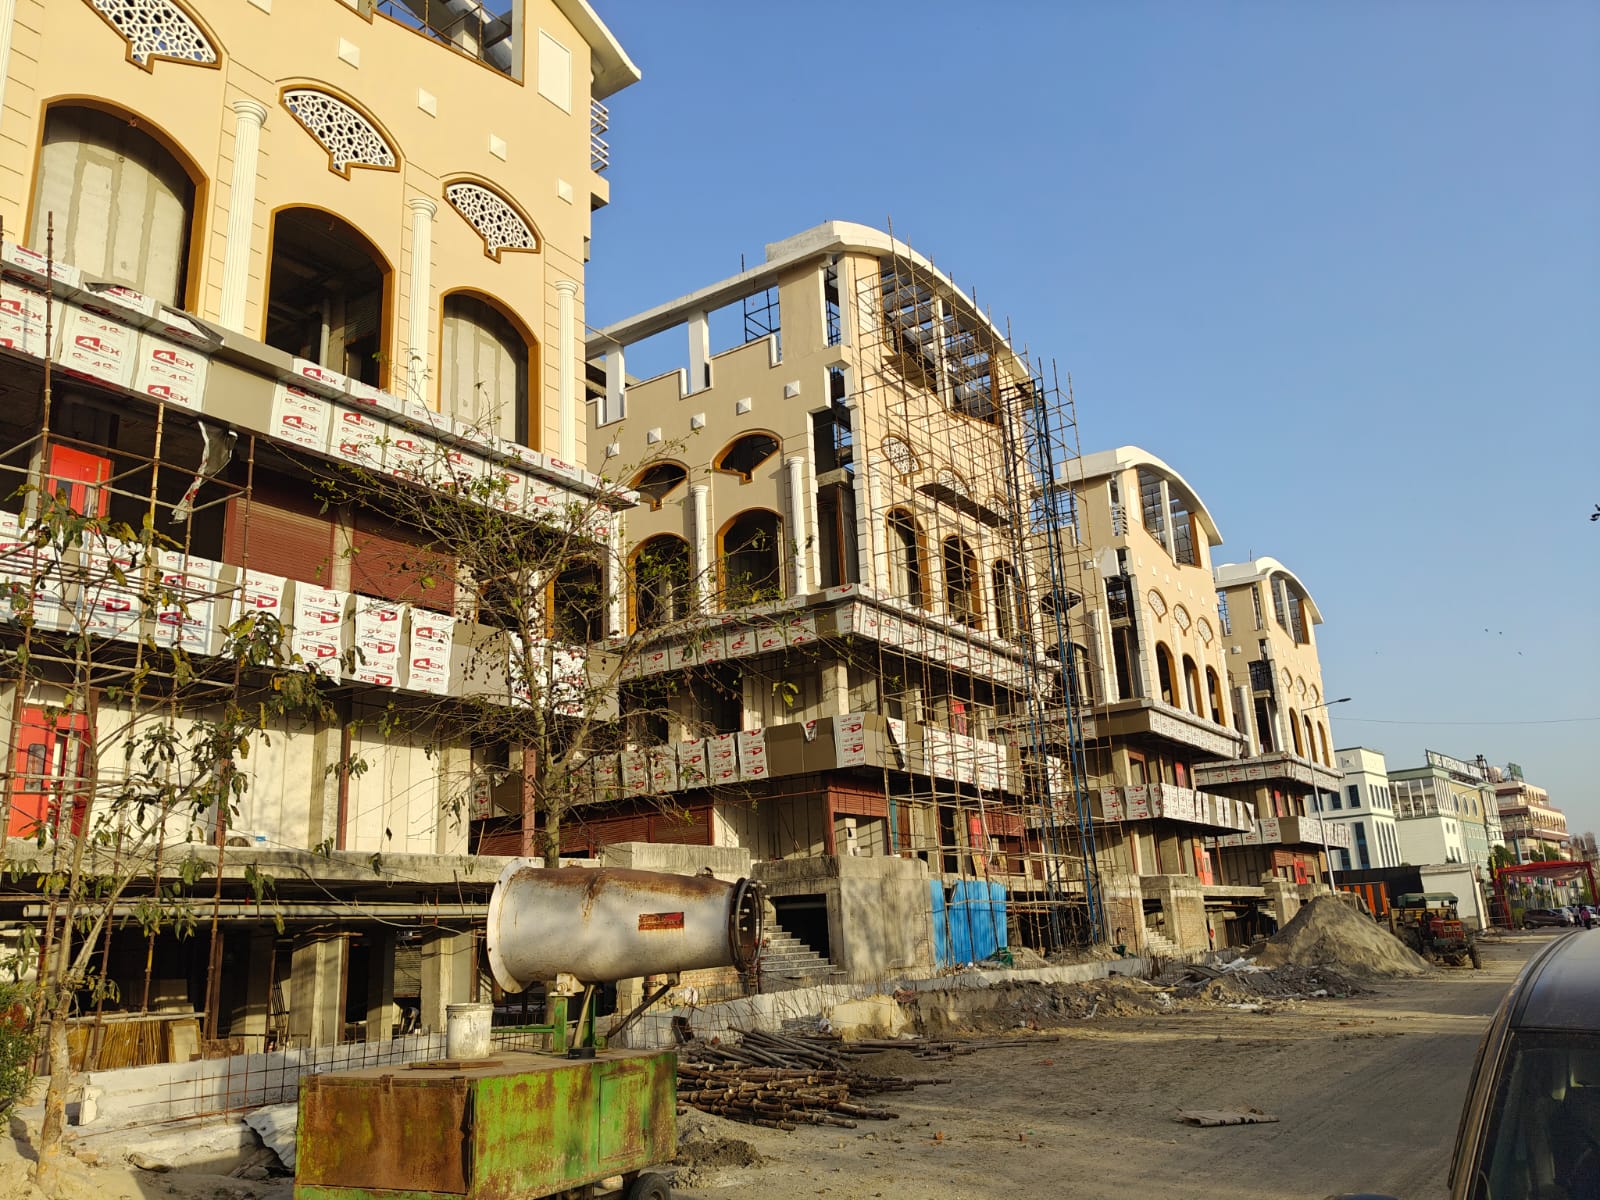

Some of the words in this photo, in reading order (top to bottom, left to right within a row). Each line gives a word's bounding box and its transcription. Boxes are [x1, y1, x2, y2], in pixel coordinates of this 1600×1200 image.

[75, 335, 120, 357] ALEX
[152, 349, 194, 369] ALEX
[303, 367, 337, 384] ALEX
[147, 384, 189, 403] ALEX
[282, 415, 317, 431] ALEX
[343, 412, 375, 428] ALEX
[301, 644, 336, 658] ALEX
[363, 641, 395, 654] ALEX
[413, 658, 444, 670] ALEX
